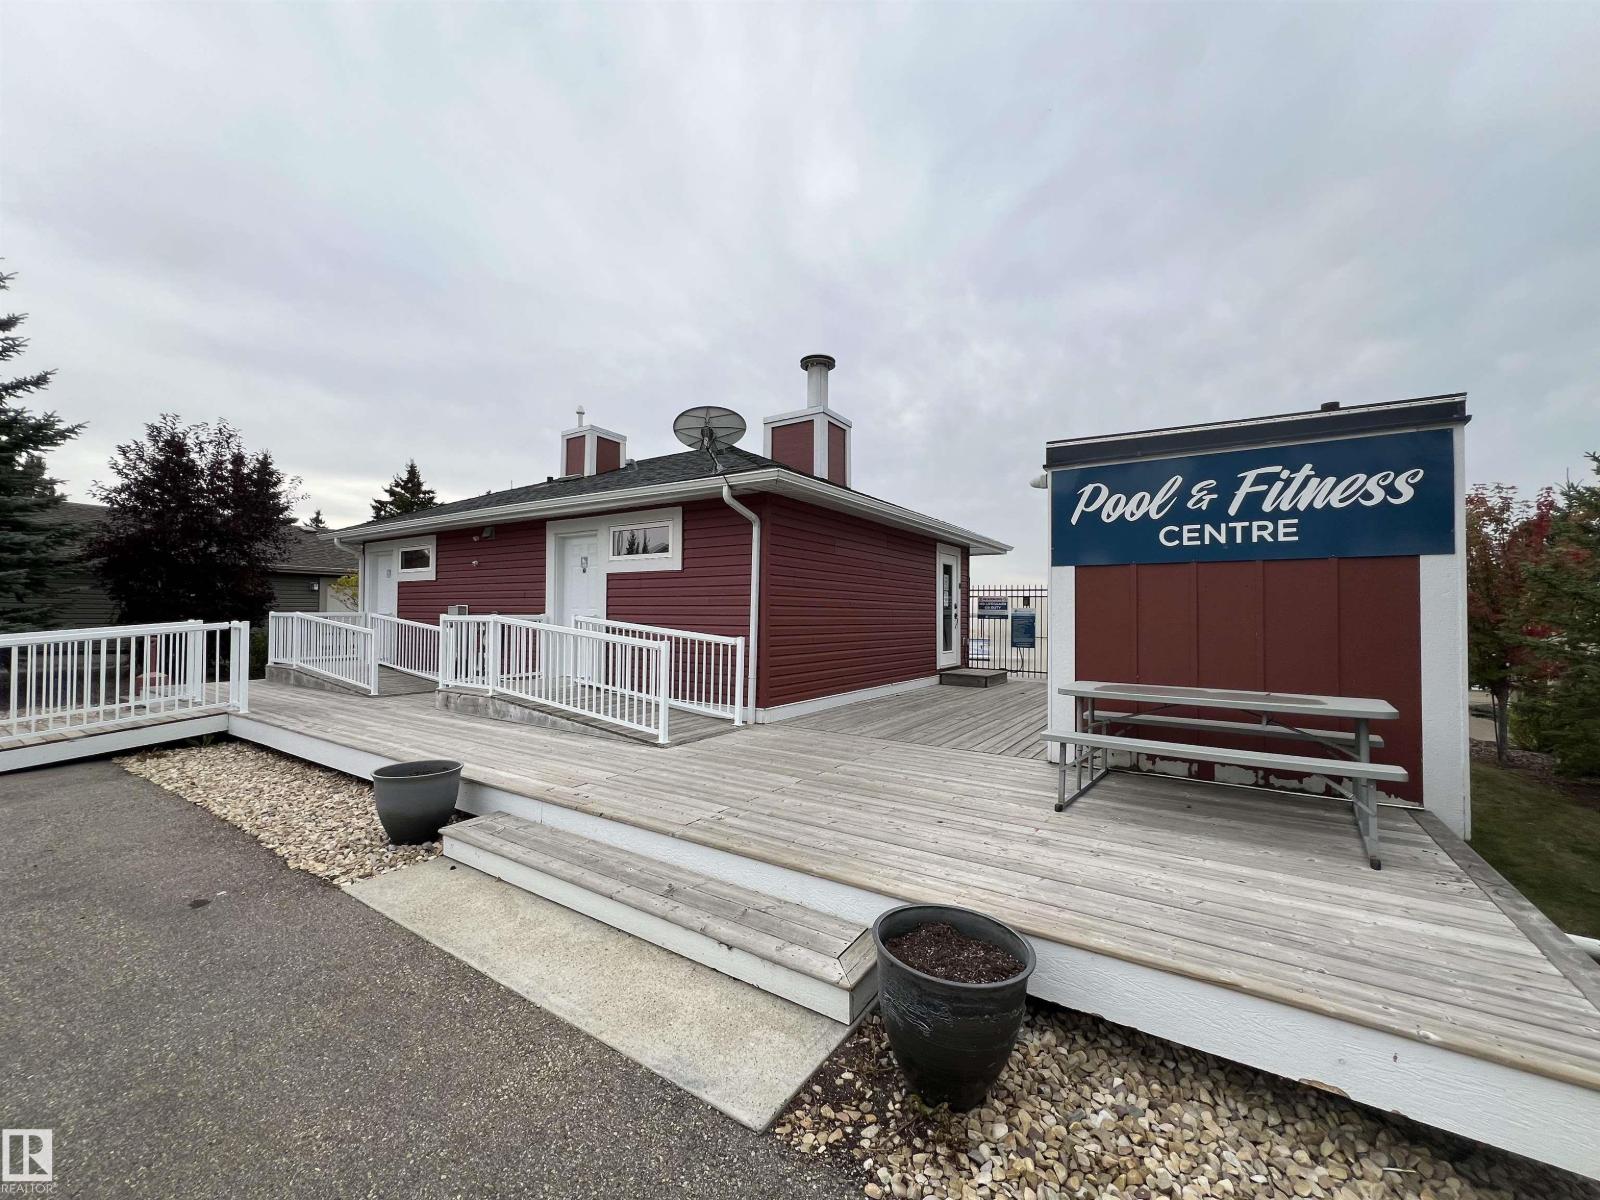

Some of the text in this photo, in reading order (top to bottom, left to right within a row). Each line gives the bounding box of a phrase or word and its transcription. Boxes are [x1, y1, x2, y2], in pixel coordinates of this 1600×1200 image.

[1070, 463, 1424, 528] Pool & Fitness
[1158, 518, 1299, 547] CENTRE
